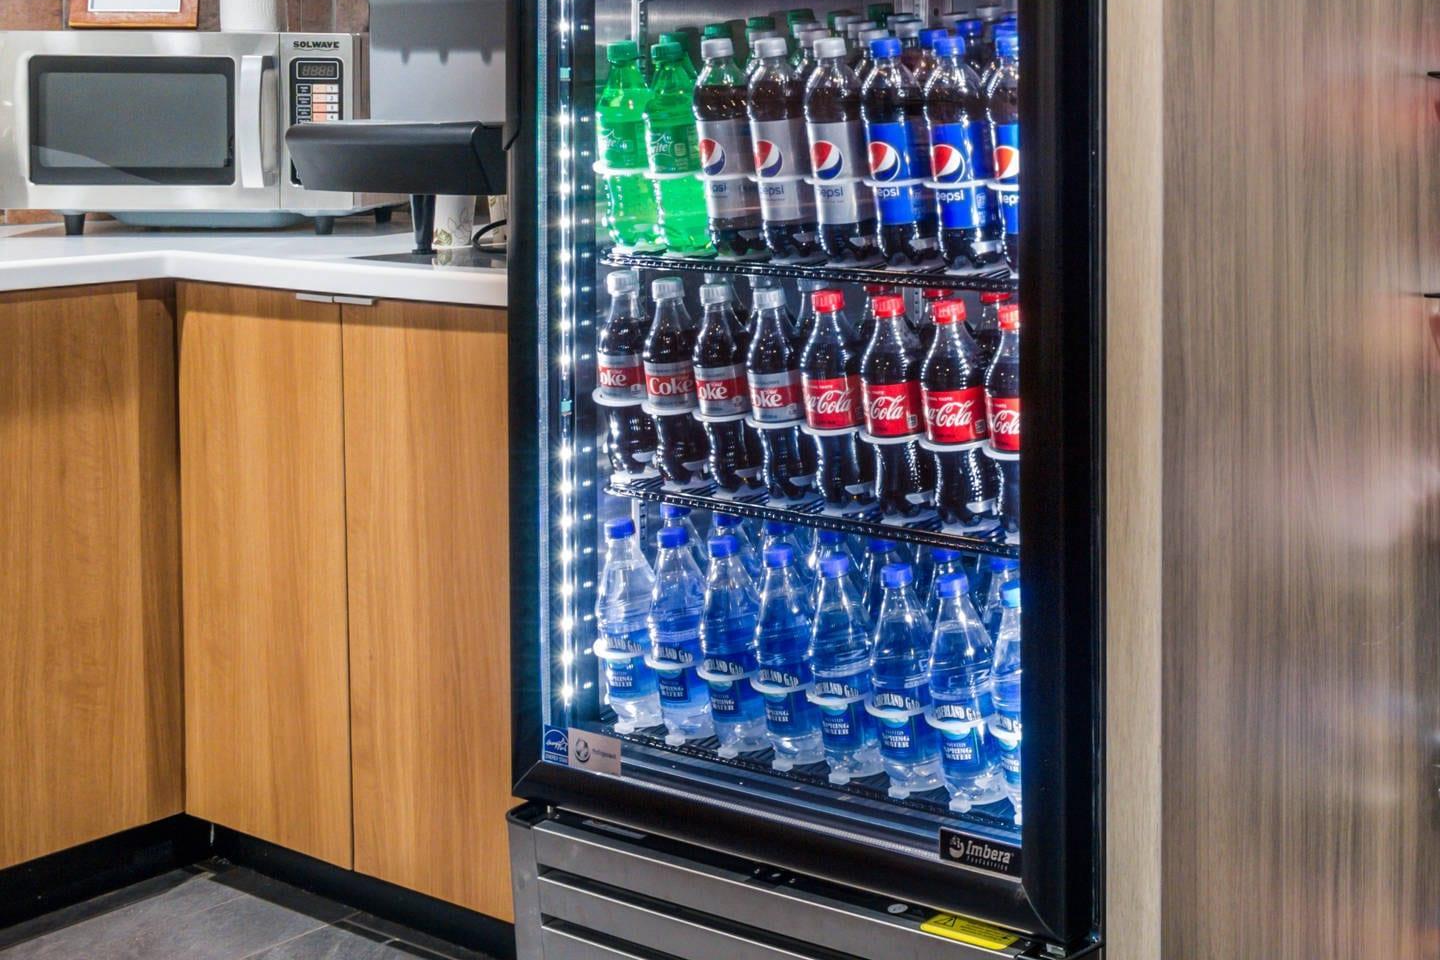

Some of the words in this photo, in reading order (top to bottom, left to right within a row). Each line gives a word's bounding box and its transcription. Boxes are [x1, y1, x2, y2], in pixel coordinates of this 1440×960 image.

[293, 40, 340, 49] SOLWAVE
[712, 183, 727, 194] psi
[762, 183, 784, 199] epsi
[820, 186, 844, 200] epsi
[878, 185, 900, 200] epsi
[600, 369, 627, 387] oke
[649, 376, 695, 396] Coke
[699, 382, 728, 400] oke
[753, 389, 784, 409] oke
[806, 390, 852, 415] a-Cola
[927, 401, 974, 428] a-Cola
[966, 841, 1012, 864] Imbera
